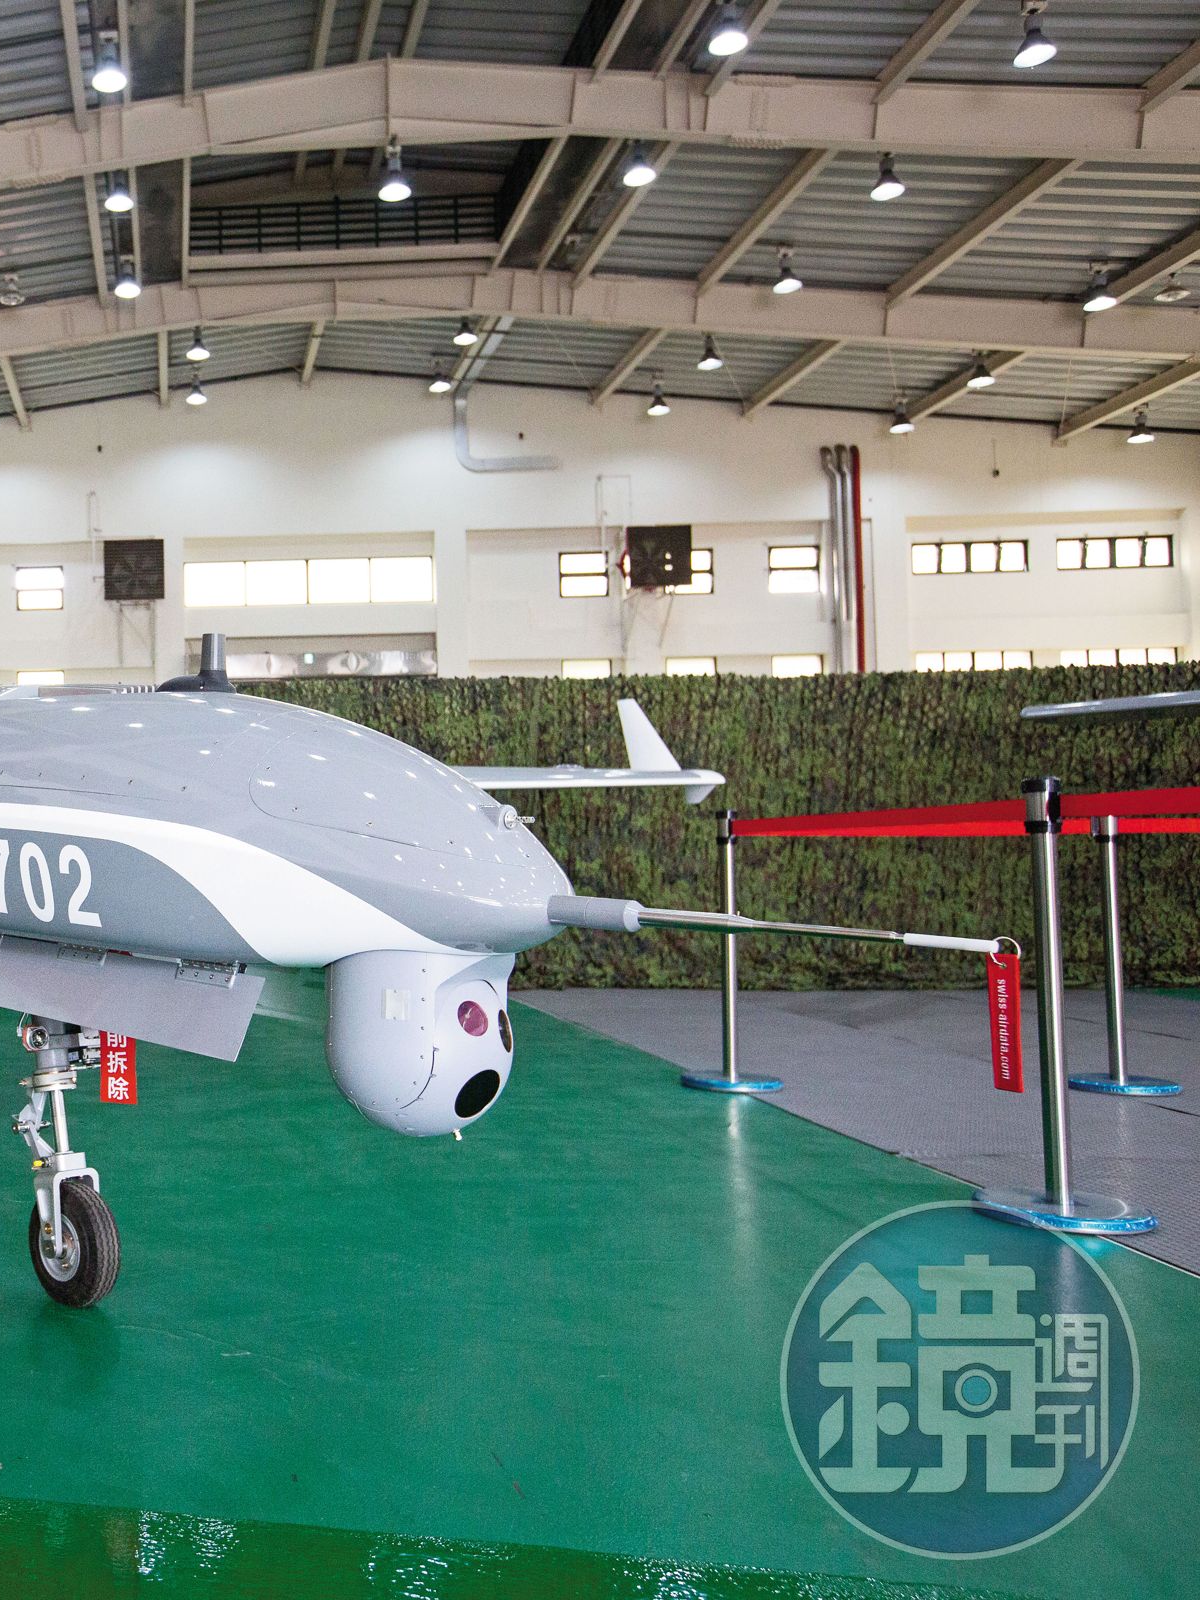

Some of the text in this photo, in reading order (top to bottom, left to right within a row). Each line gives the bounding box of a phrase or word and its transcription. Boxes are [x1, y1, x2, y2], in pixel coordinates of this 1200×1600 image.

[107, 1031, 129, 1101] 前拆除
[997, 979, 1011, 1081] swiss-airdata.com
